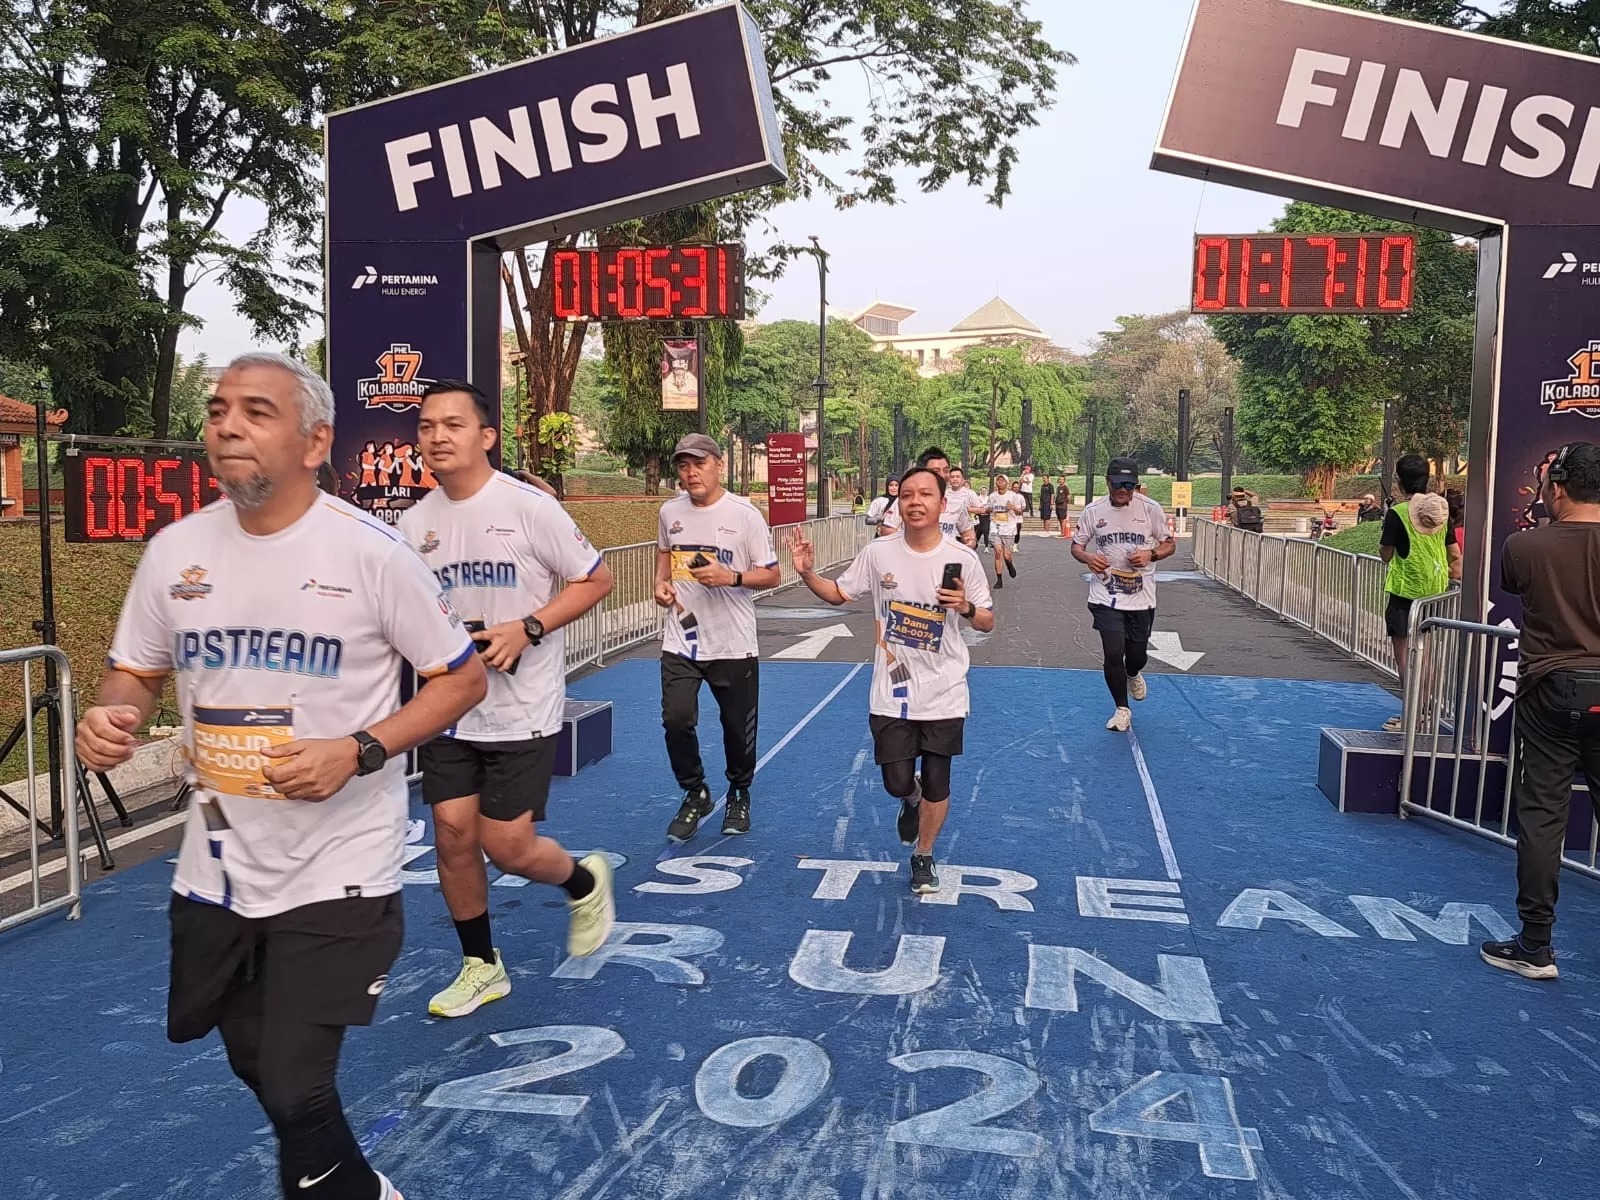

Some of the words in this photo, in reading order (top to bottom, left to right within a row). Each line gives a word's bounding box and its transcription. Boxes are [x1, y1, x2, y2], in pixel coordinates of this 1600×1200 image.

[384, 61, 701, 212] FINISH
[381, 275, 439, 285] PERTAMINA
[554, 247, 727, 317] 01:05:31
[1196, 236, 1413, 309] 01:17:10
[381, 288, 400, 296] HULU
[401, 288, 427, 296] ENERGI
[379, 354, 421, 383] 17
[1545, 384, 1600, 401] KOLABO
[384, 486, 411, 498] LARI
[895, 624, 934, 640] AB-0074
[902, 616, 929, 629] Danu
[551, 921, 1223, 1025] RUN
[422, 1024, 1263, 1180] 2024
